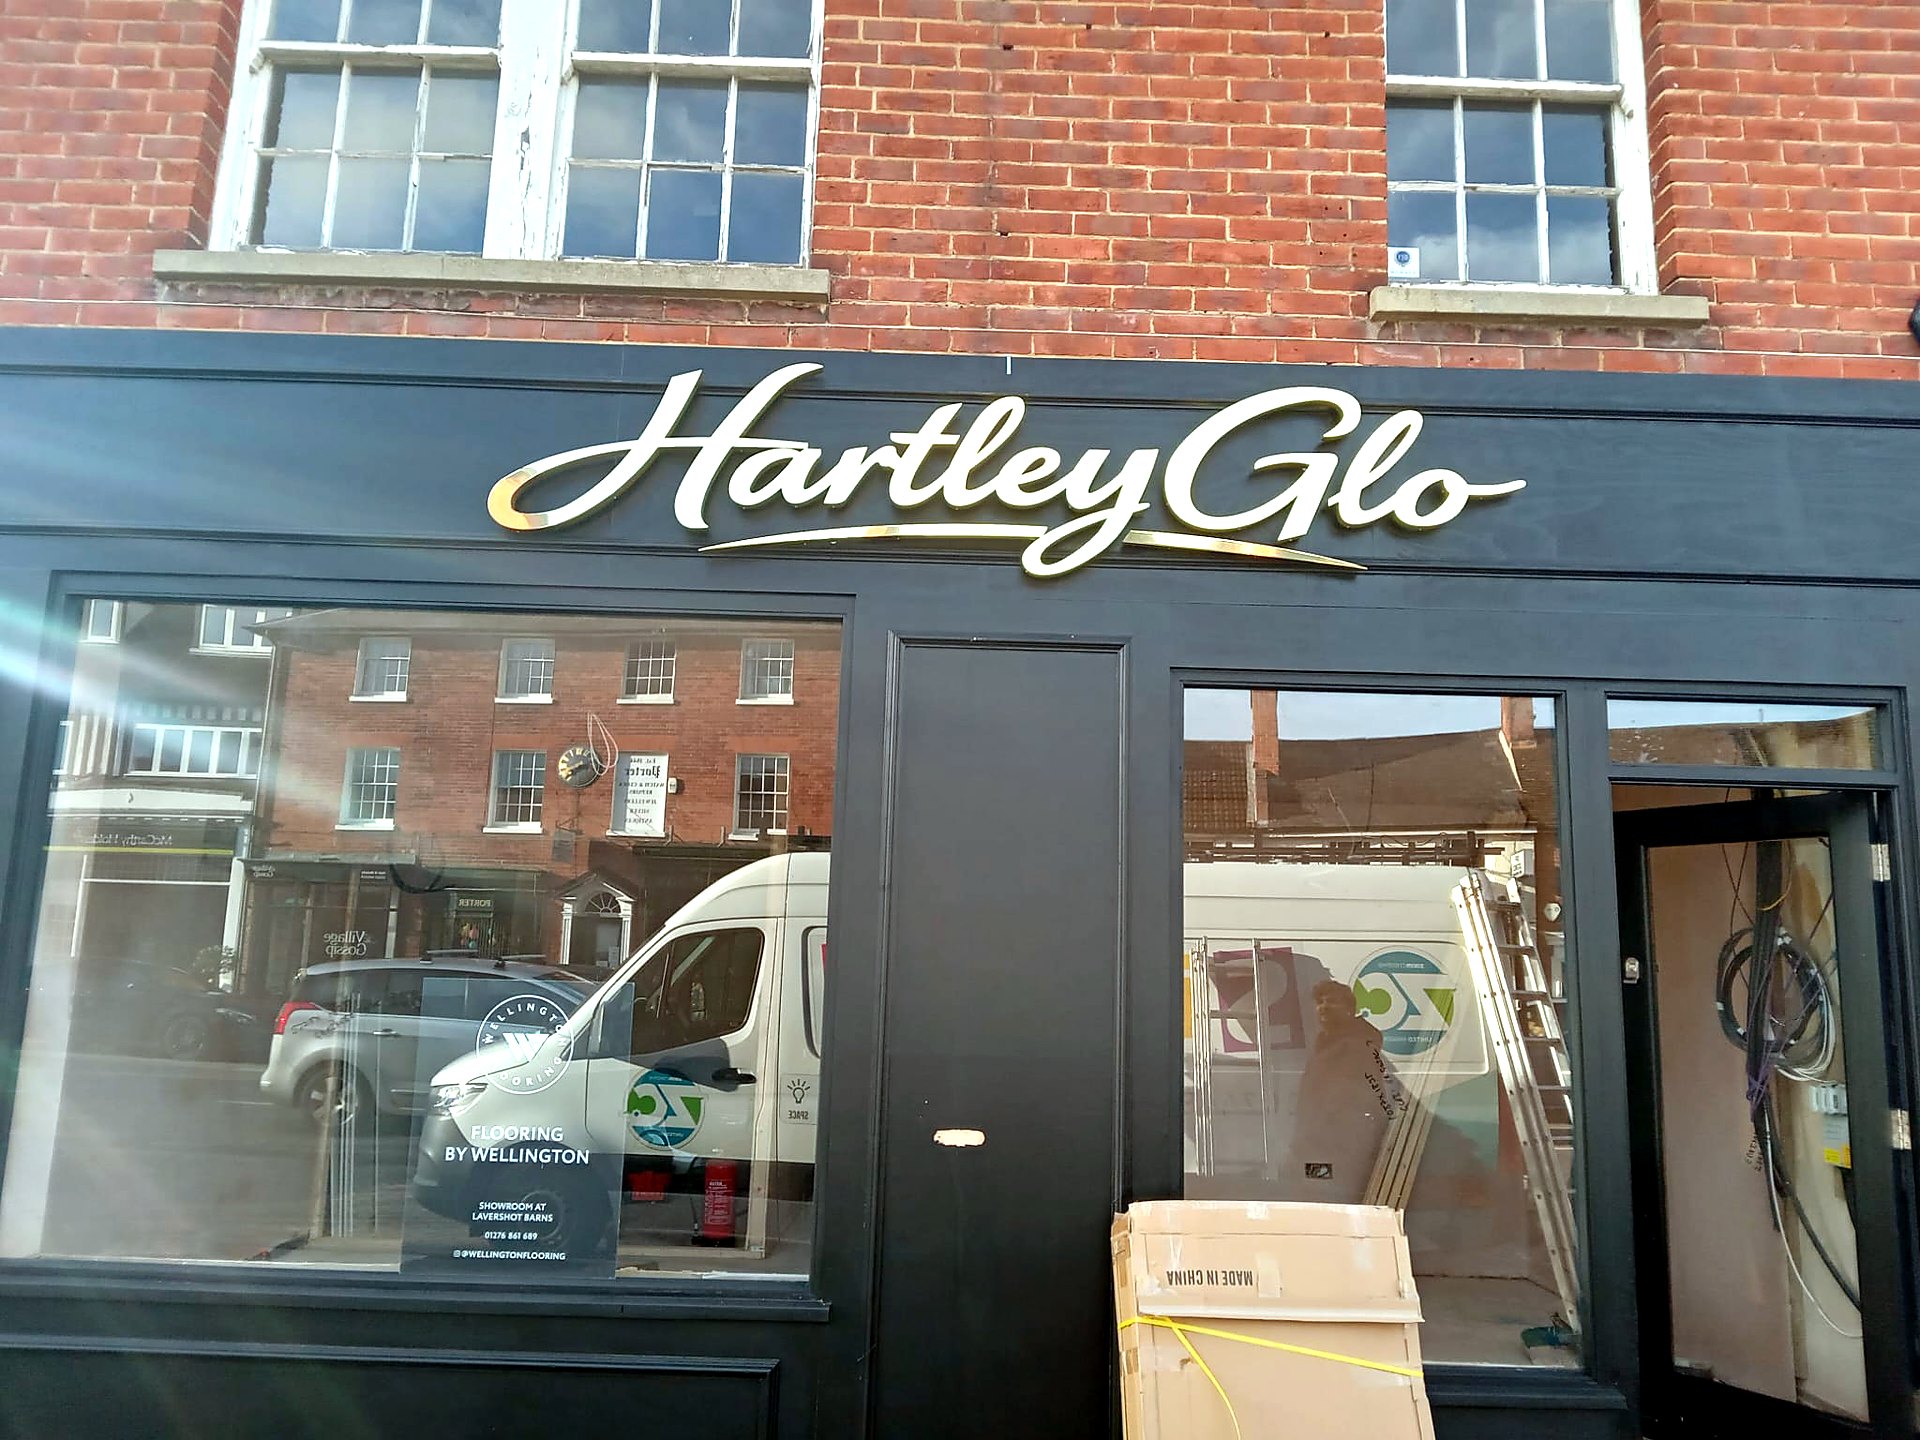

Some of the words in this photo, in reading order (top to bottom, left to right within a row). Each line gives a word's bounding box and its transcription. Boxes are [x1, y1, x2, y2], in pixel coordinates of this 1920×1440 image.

[471, 1125, 564, 1142] FLOORING
[445, 1146, 468, 1162] BY
[471, 1147, 590, 1165] WELLINGTON
[479, 1201, 534, 1212] SHOWROOM
[534, 1203, 547, 1212] AT
[472, 1212, 523, 1222] LAVERSHOT
[523, 1213, 554, 1223] BARNS
[484, 1231, 506, 1240] 01276
[507, 1231, 521, 1240] 861
[522, 1231, 538, 1241] 689
[461, 1249, 567, 1261] @WELLINGTONFLOORING
[1166, 1269, 1204, 1286] CHINA
[1206, 1269, 1220, 1286] IN
[1221, 1270, 1254, 1287] MADE
